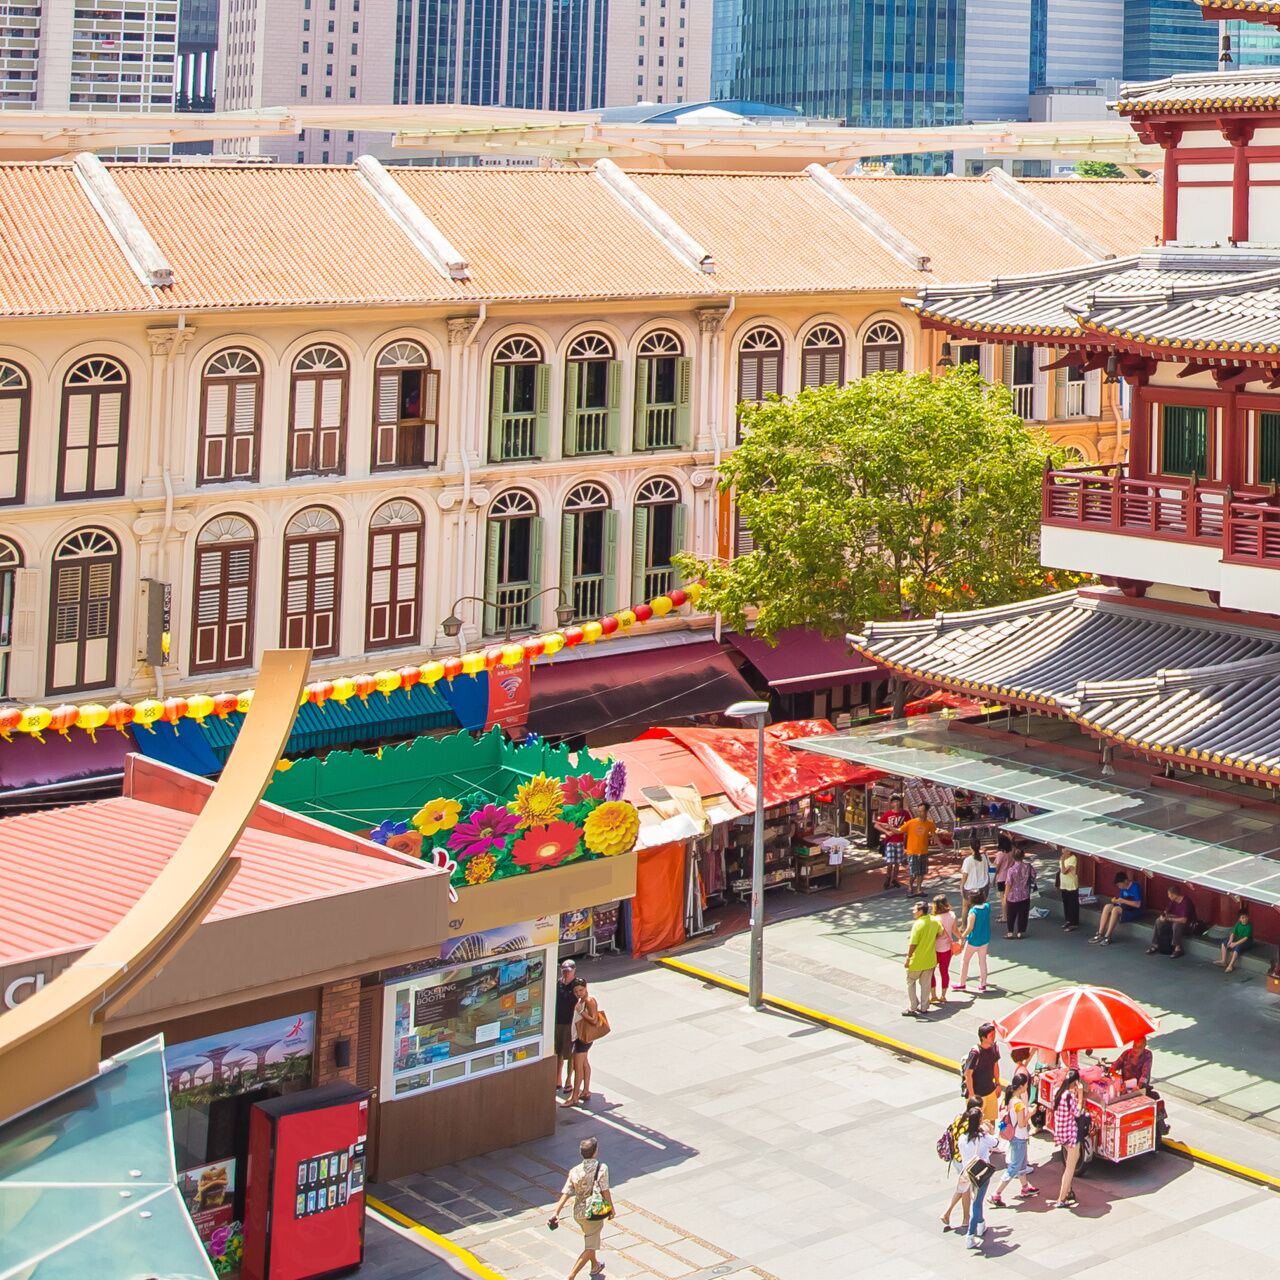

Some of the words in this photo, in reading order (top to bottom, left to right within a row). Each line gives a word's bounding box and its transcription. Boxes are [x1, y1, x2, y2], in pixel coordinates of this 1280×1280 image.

[448, 918, 464, 929] ay
[416, 984, 456, 999] TICKETING
[416, 993, 446, 1005] BOOTH
